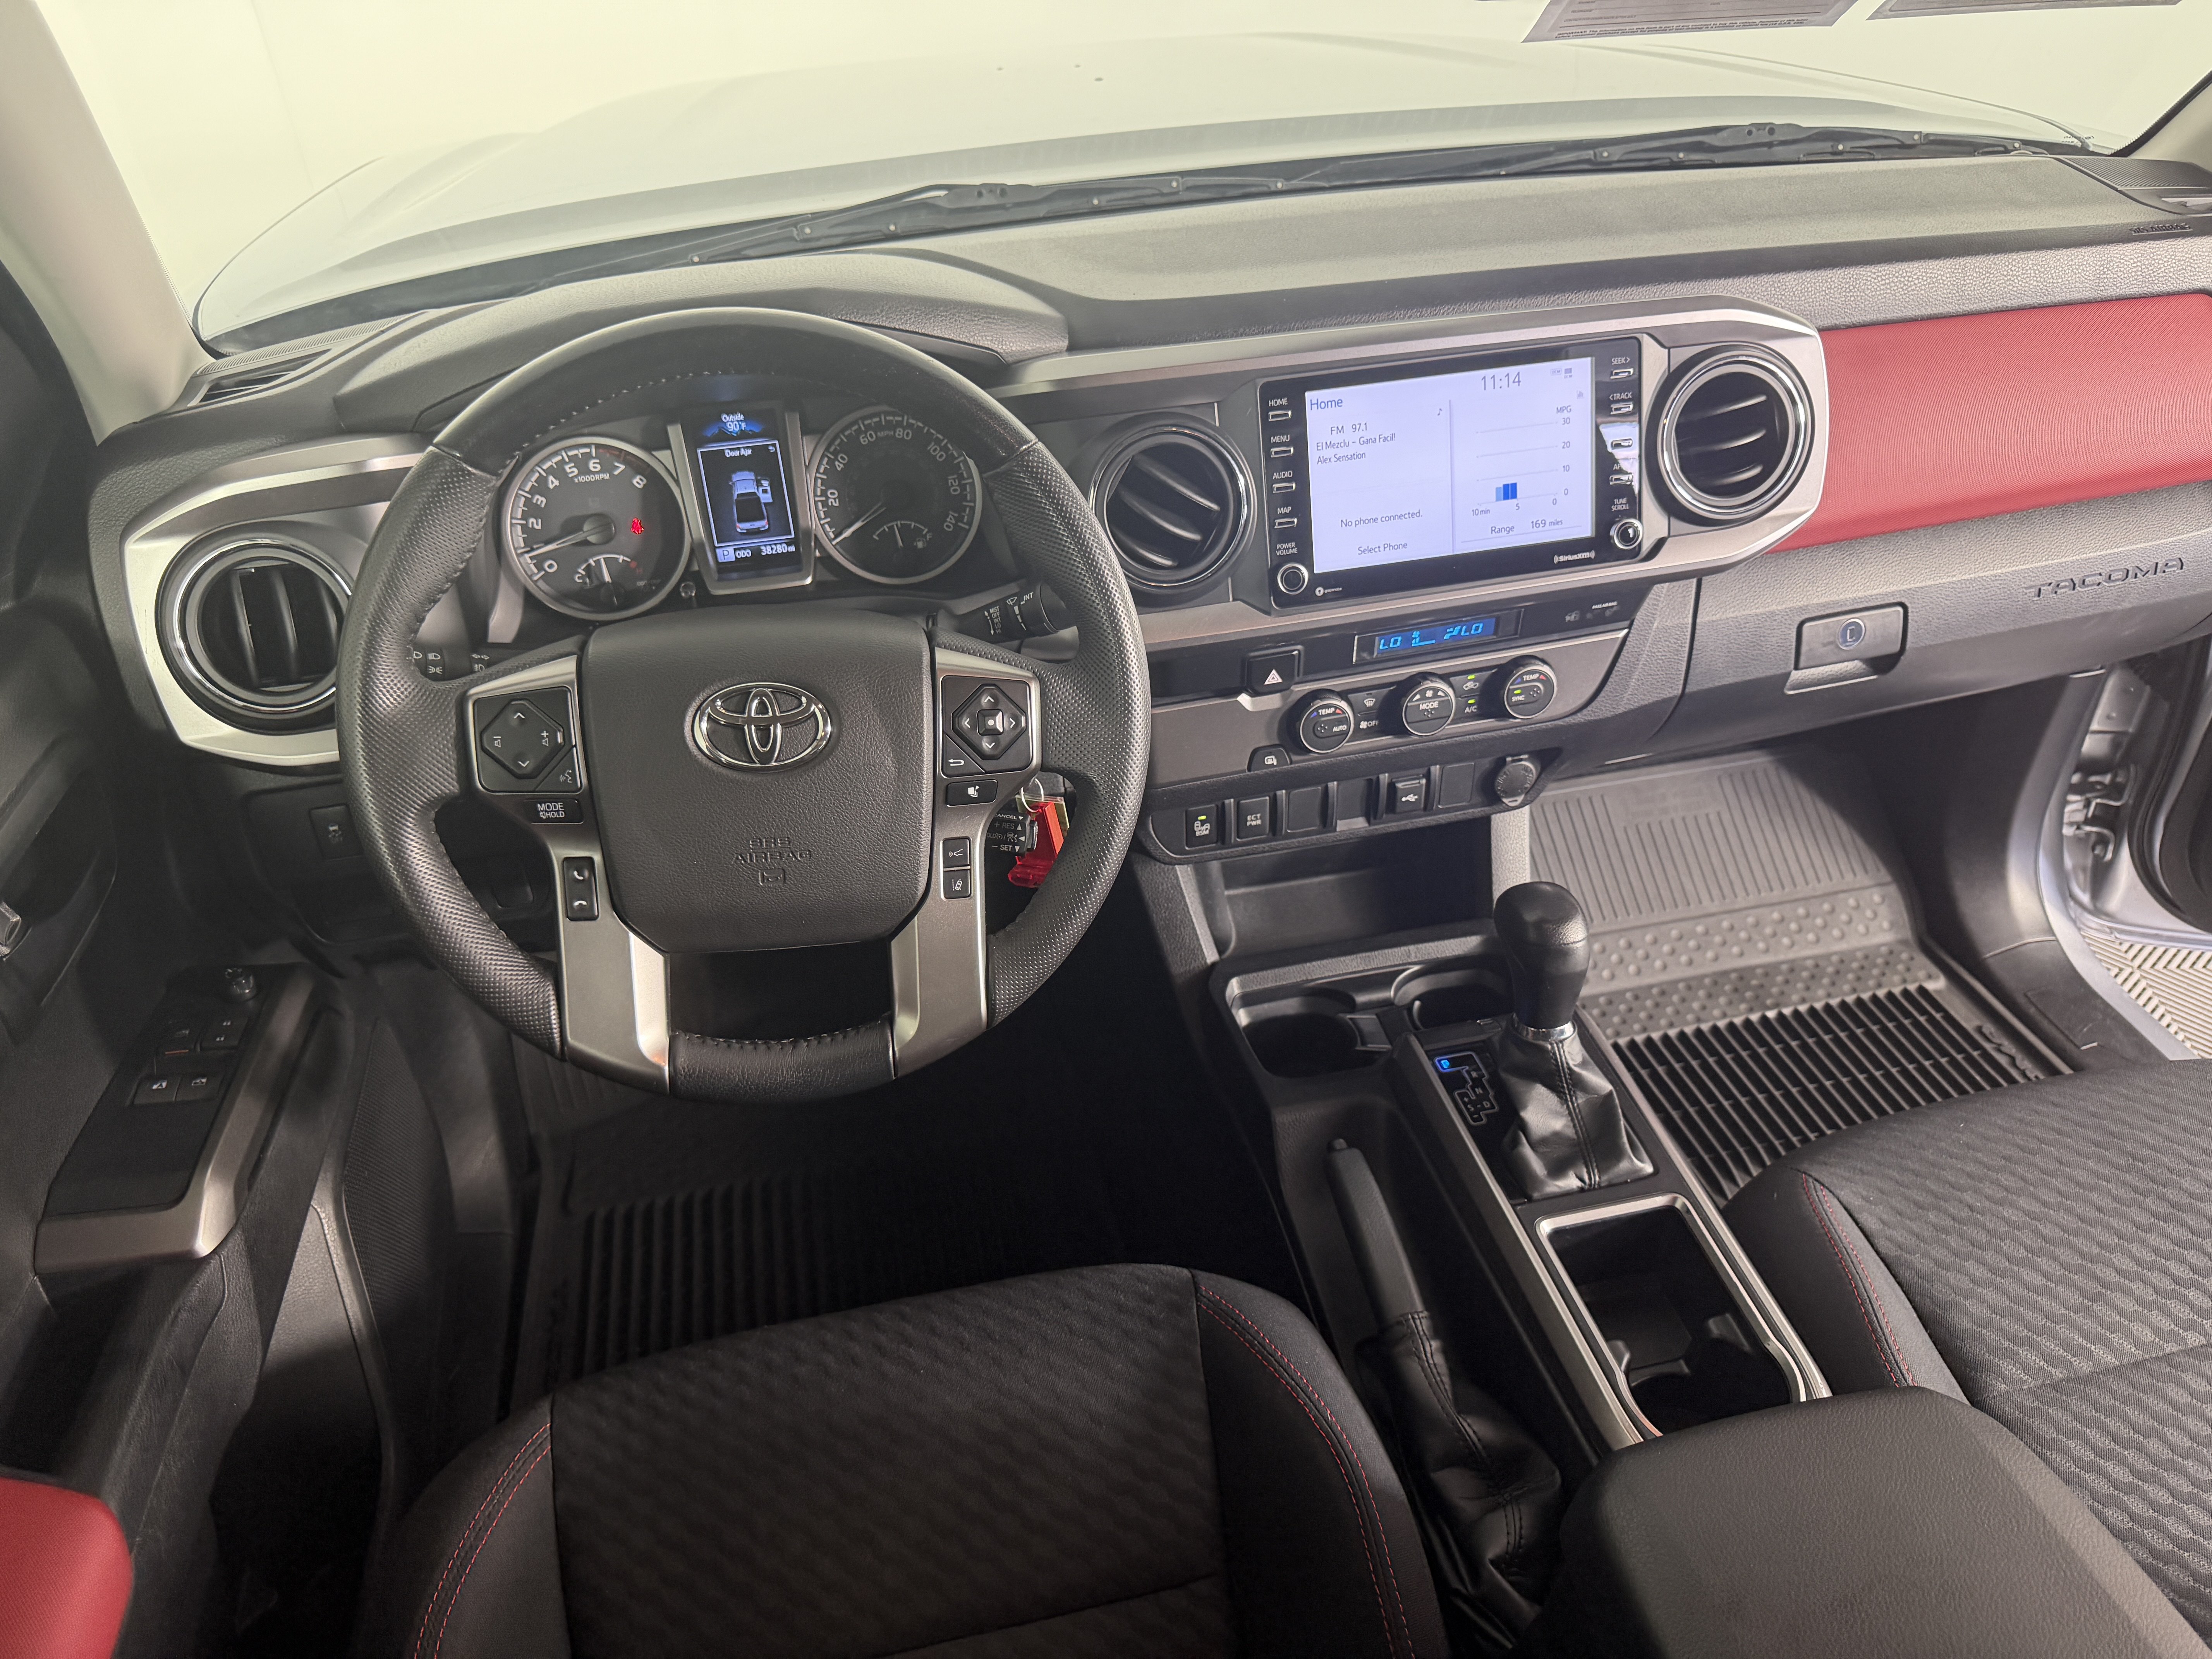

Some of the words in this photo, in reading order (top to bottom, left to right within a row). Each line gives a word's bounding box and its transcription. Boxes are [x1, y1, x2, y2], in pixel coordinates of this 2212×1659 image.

[1480, 371, 1522, 391] 11:14
[1269, 398, 1288, 407] HOME
[1613, 392, 1632, 400] TRACK
[1310, 398, 1343, 410] Home
[1556, 405, 1571, 414] MPG
[721, 412, 744, 422] Outside
[1562, 417, 1571, 425] 30
[895, 428, 912, 440] 80
[1331, 425, 1345, 435] FM
[1352, 422, 1367, 433] 97.1
[859, 430, 876, 445] 60
[1271, 434, 1290, 443] MENU
[1316, 442, 1323, 451] El
[1325, 439, 1350, 450] Mezclu
[1358, 436, 1376, 445] Gana
[1378, 433, 1396, 443] Facil!
[927, 442, 946, 461] 100
[1562, 441, 1571, 449] 20
[724, 448, 740, 457] Door
[740, 448, 752, 457] Ajar
[1317, 455, 1332, 465] Alex
[1334, 452, 1366, 463] Sensation
[589, 459, 601, 472] 6
[613, 462, 625, 475] 7
[835, 453, 848, 471] 40
[564, 463, 579, 477] 5
[1273, 471, 1293, 479] AUDIO
[548, 475, 560, 489] 4
[632, 475, 647, 489] 8
[948, 475, 960, 495] 120
[533, 495, 547, 508] 3
[827, 489, 839, 507] 20
[528, 517, 541, 530] 2
[943, 511, 958, 532] 140
[1341, 519, 1353, 527] No
[1355, 517, 1378, 527] phone
[1380, 509, 1423, 522] connected.
[1491, 526, 1515, 534] Range
[1531, 519, 1546, 529] 169
[722, 550, 729, 560] P
[735, 548, 752, 558] ODO
[760, 543, 788, 555] 38280
[1358, 545, 1381, 555] Select
[1383, 543, 1408, 551] Phone
[544, 559, 558, 573] 0
[575, 574, 583, 582] C
[2024, 557, 2185, 601] TACOMA
[1024, 592, 1034, 601] INT
[989, 606, 999, 614] MIST
[1461, 622, 1484, 636] LO
[1379, 636, 1402, 649] LO
[1318, 708, 1335, 716] TEMP
[1419, 701, 1439, 710] MODE
[1465, 705, 1477, 713] A/C
[537, 802, 564, 811] MODE
[749, 836, 791, 850] SRS
[734, 849, 812, 864] AIRBAG
